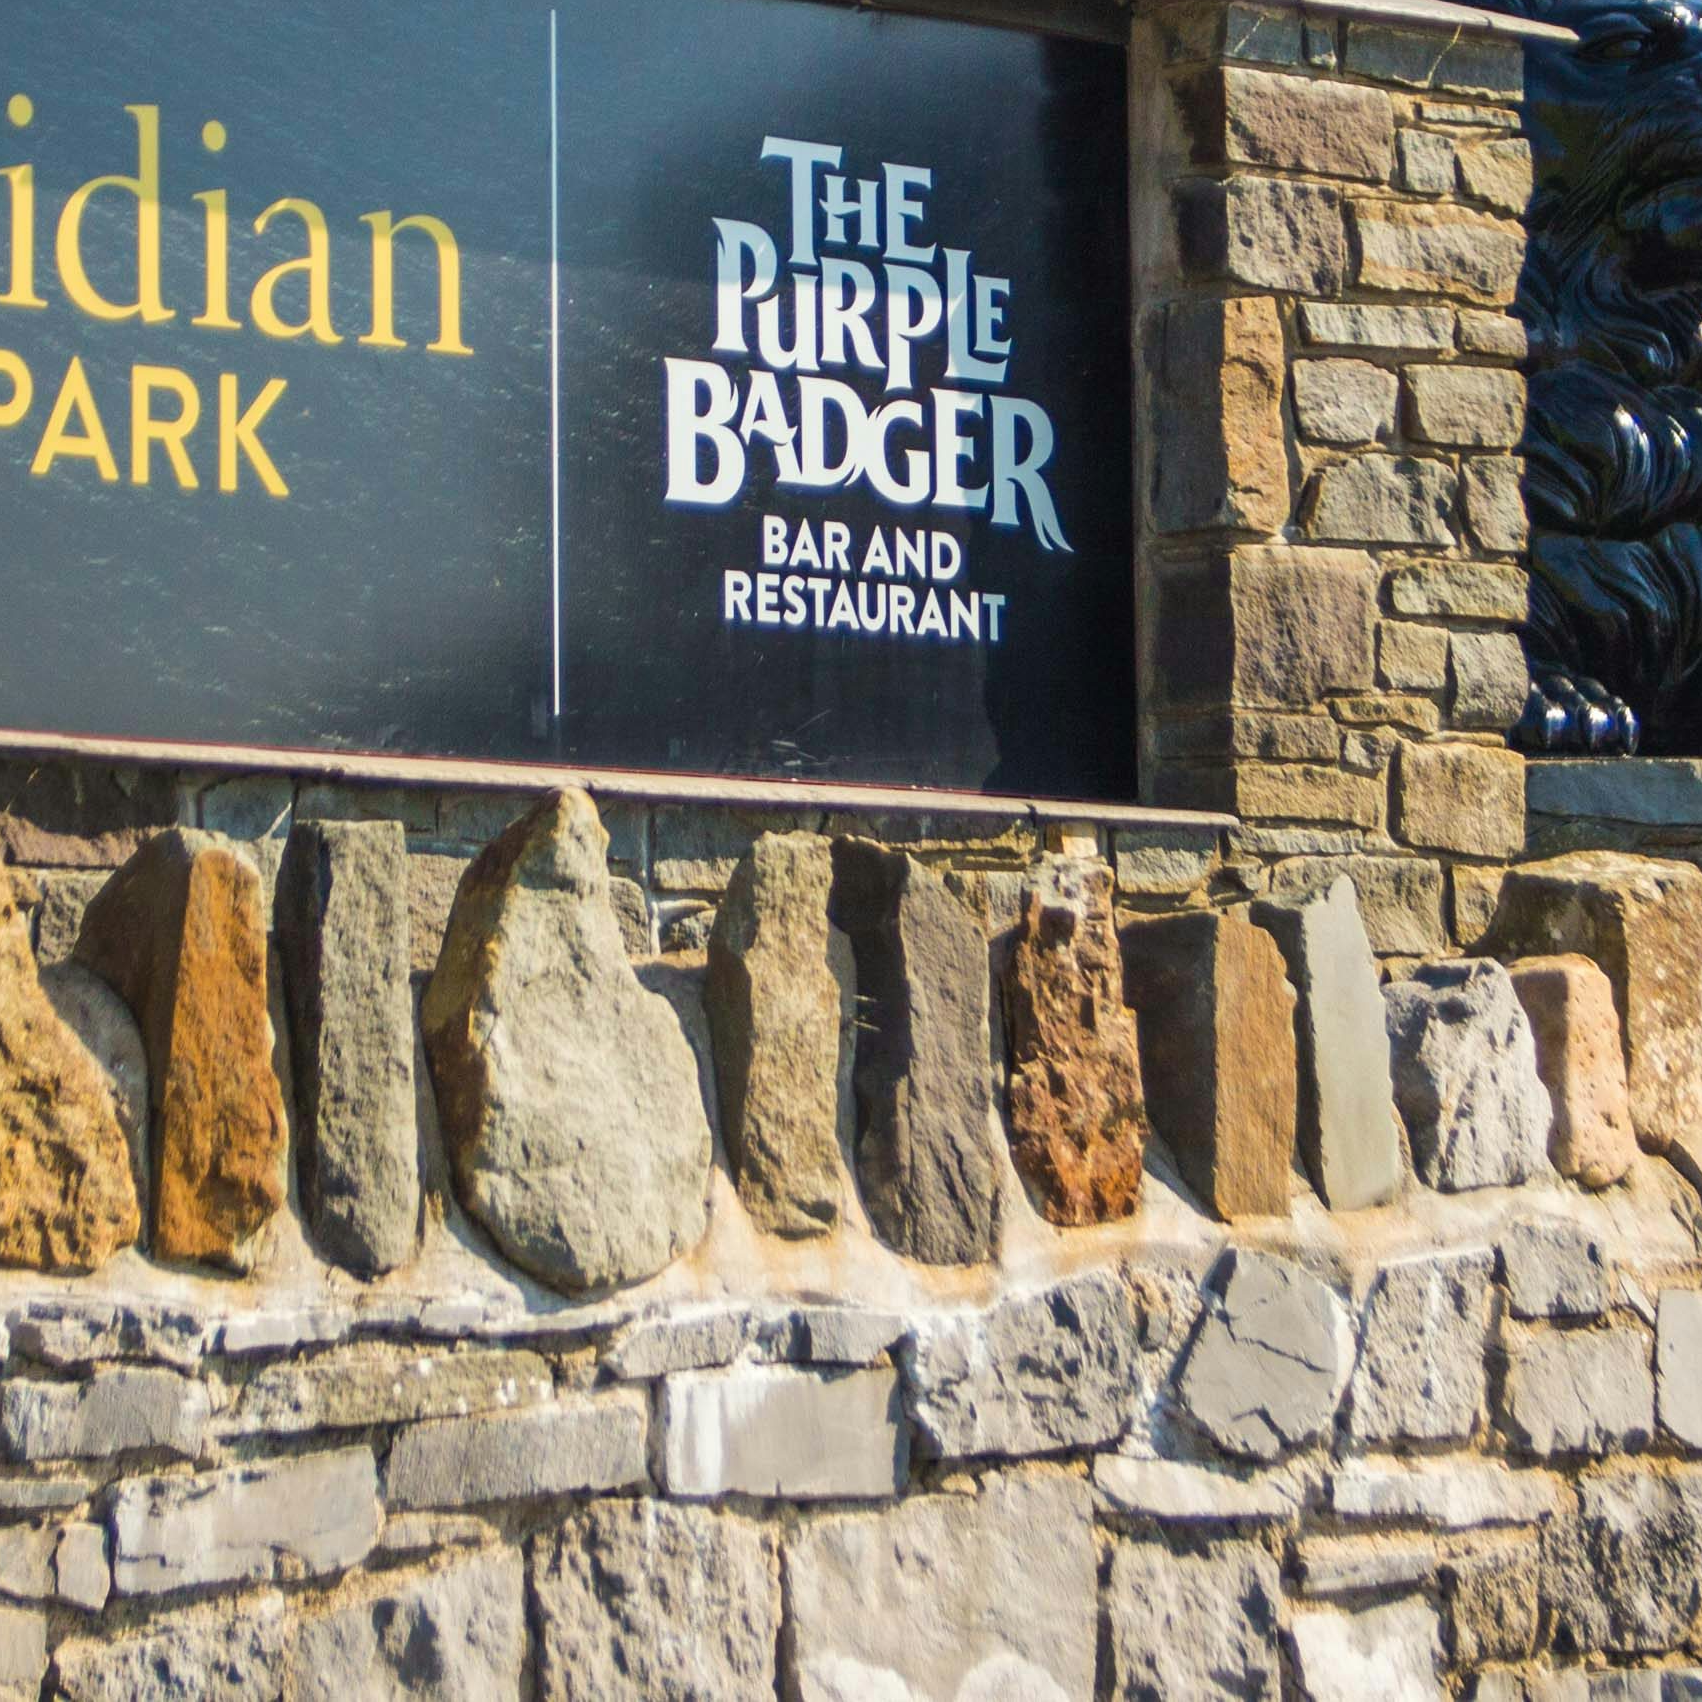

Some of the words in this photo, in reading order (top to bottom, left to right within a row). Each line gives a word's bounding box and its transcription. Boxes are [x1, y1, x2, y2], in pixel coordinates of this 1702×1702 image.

[760, 135, 938, 267] THE
[711, 217, 1012, 391] PURPLE
[664, 356, 1074, 552] BADGER
[724, 569, 1006, 641] RESTAURANT
[762, 514, 850, 571] BAR
[863, 526, 962, 579] AND
